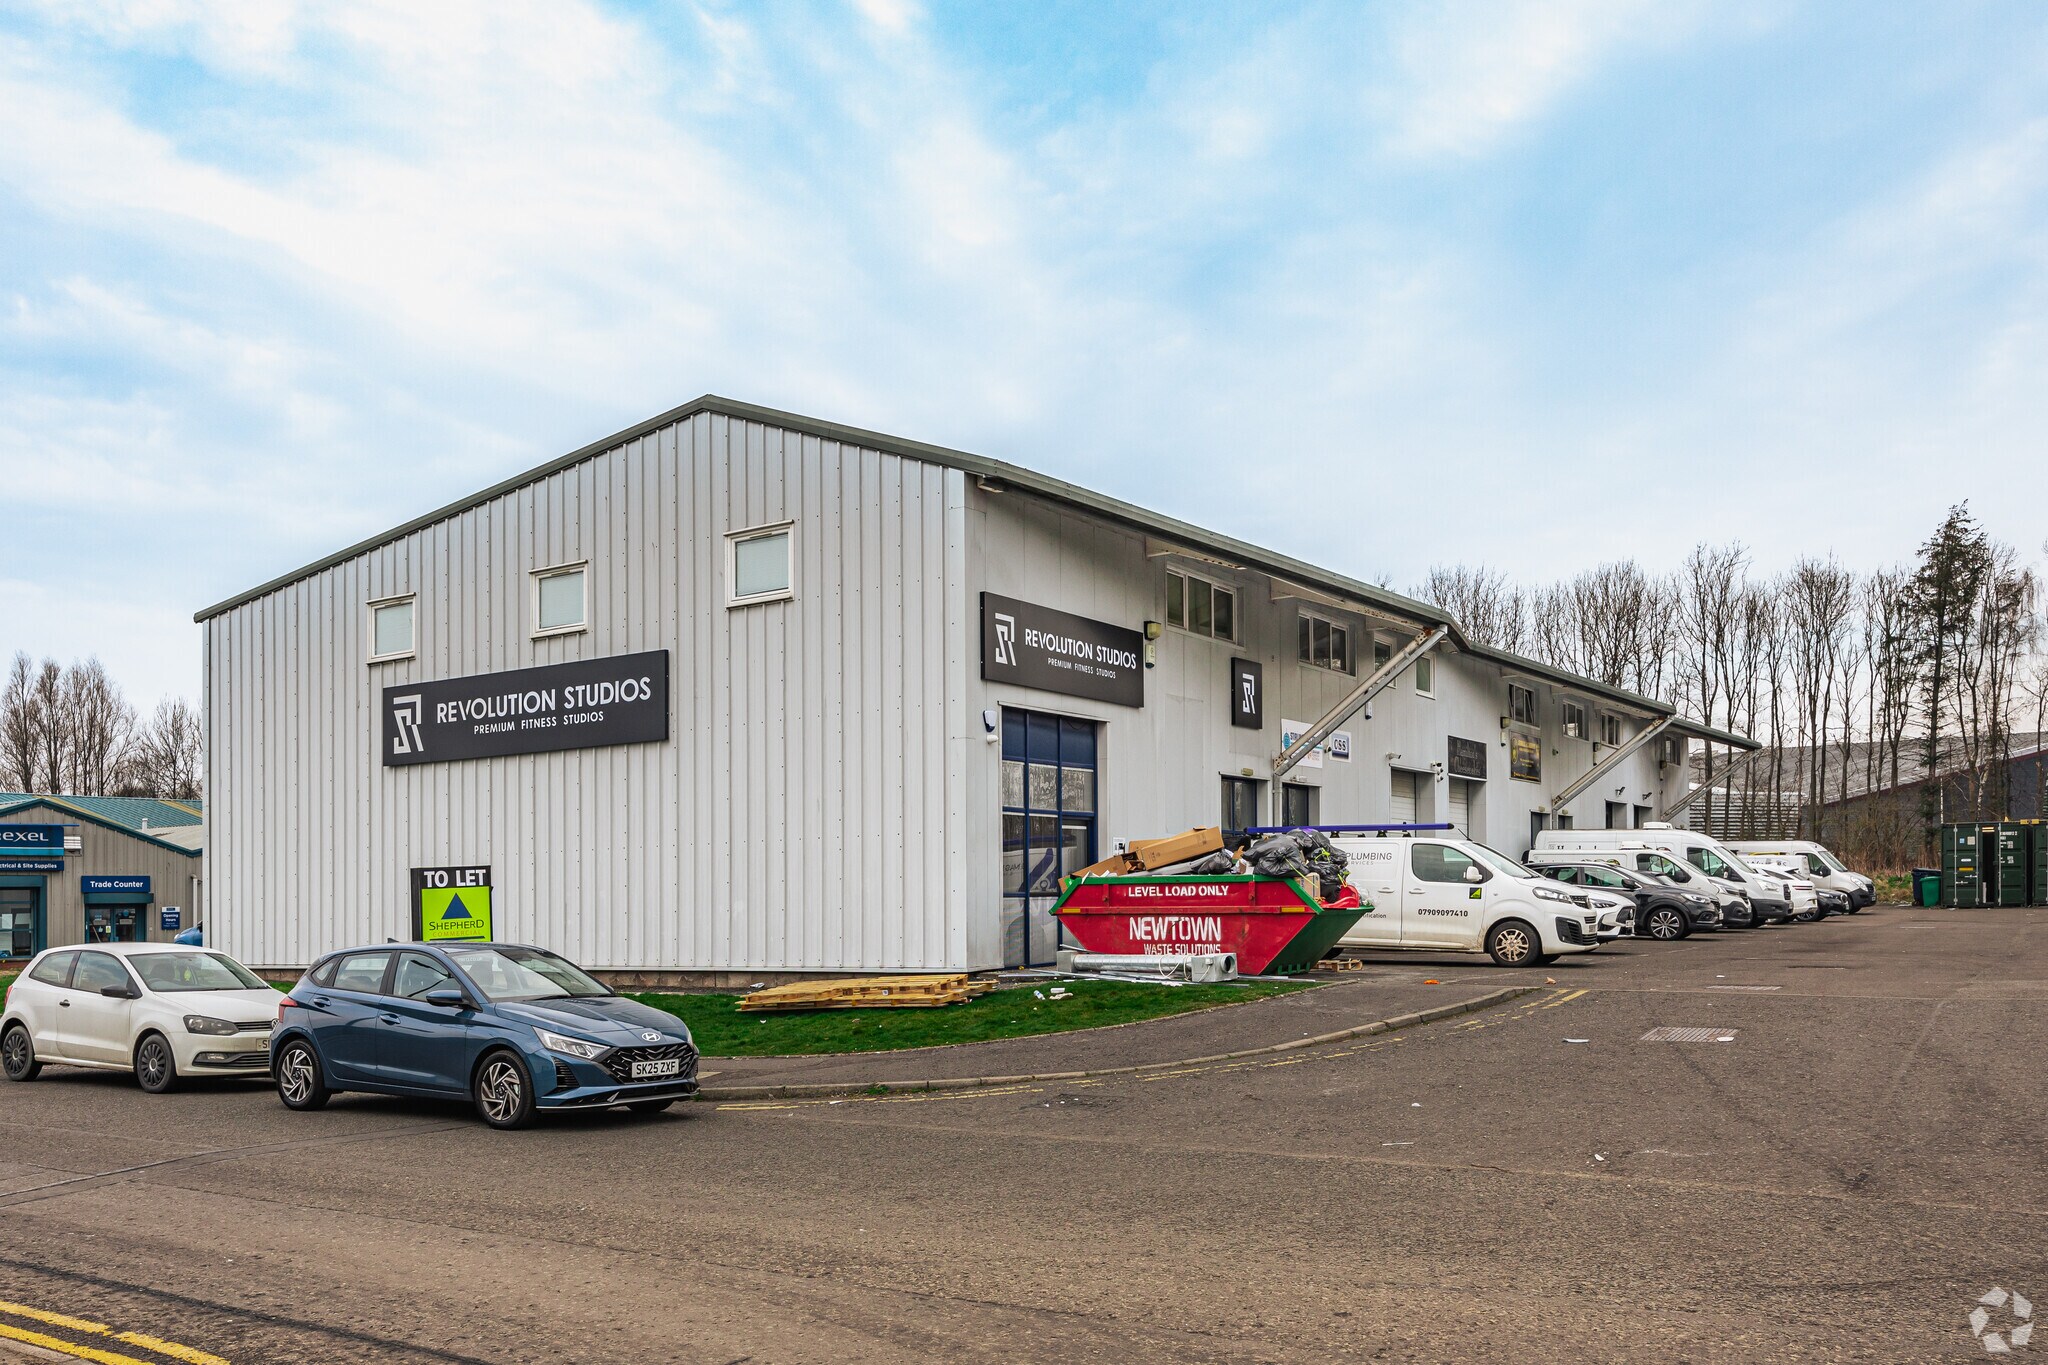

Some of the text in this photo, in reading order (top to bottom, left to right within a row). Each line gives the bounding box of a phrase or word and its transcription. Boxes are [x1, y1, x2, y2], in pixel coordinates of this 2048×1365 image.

[1025, 628, 1137, 670] REVOLUTION STUDIOS
[1048, 657, 1116, 679] PREMIUM FITNESS STUDIOS
[437, 676, 651, 724] REVOLUTION STUDIOS
[473, 711, 604, 735] PREMIUM FITNESS STUDIOS
[1346, 852, 1393, 861] PLUMBING
[423, 869, 487, 888] TO LET
[1128, 885, 1230, 897] LEVEL LOAD ONLY
[1129, 916, 1222, 941] NEWTOWN
[1143, 943, 1221, 956] WASTE SOLUTIONS
[636, 1061, 676, 1075] SK25 ZXF
